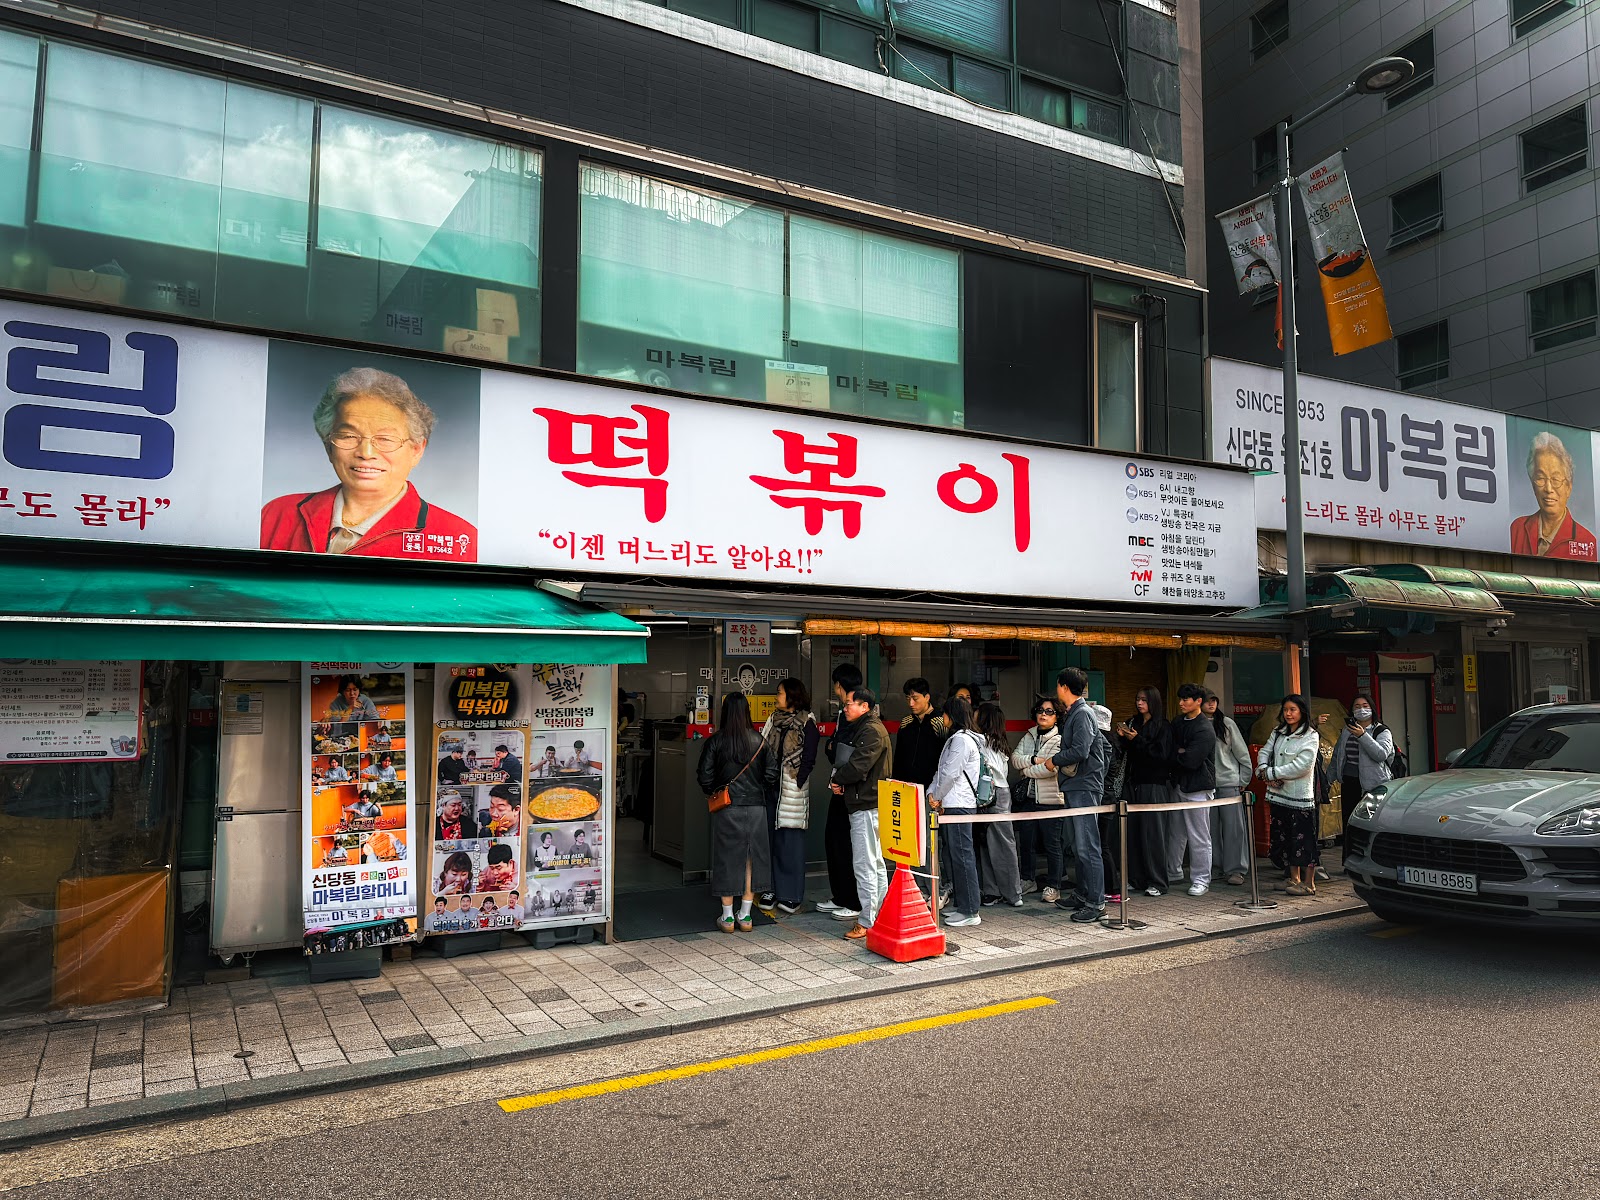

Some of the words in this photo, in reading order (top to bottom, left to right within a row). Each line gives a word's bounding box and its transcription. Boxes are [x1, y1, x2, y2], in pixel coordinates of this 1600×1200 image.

[387, 313, 423, 336] 마복림
[646, 348, 736, 378] 마복림
[836, 375, 918, 401] 마복림
[3, 320, 179, 480] 림
[1236, 388, 1283, 414] SINCE
[1298, 399, 1325, 421] 953
[1226, 427, 1274, 471] 신당동
[1340, 405, 1498, 504] 마복림
[532, 403, 1031, 553] 떡볶이
[1139, 467, 1154, 478] SBS
[1159, 469, 1173, 480] 리얼
[1176, 471, 1197, 483] 코리아
[1138, 489, 1153, 498] KBS
[1159, 484, 1171, 493] 6시
[1174, 485, 1195, 496] 내고향
[1160, 494, 1189, 506] 무엇이든
[1190, 497, 1225, 509] 물어보세요
[1139, 513, 1153, 521] KBS
[1161, 508, 1171, 517] VJ
[1173, 509, 1194, 520] 특공대
[1355, 505, 1383, 529] 몰라
[1389, 509, 1430, 531] 아무도
[1161, 518, 1182, 530] 생방송
[1184, 520, 1205, 531] 전국은
[1207, 523, 1222, 534] 지금
[428, 534, 454, 547] 마복림
[1161, 533, 1182, 544] 아침을
[1185, 535, 1206, 547] 달린다
[619, 536, 717, 568] 며느리도
[1161, 558, 1181, 569] 맛있는
[1183, 560, 1203, 571] 녀석들
[1130, 570, 1153, 582] tvN
[1161, 572, 1168, 582] 유
[1170, 573, 1184, 583] 퀴즈
[1185, 573, 1193, 583] 온
[1194, 574, 1201, 584] 더
[1134, 584, 1150, 597] CF
[1161, 586, 1182, 598] 해찬들
[1184, 588, 1204, 599] 태양초
[1206, 590, 1225, 601] 고추장
[730, 624, 758, 636] 포장은
[739, 636, 767, 648] 안으로
[457, 680, 510, 698] 마복림
[457, 698, 509, 715] 떡볶이
[534, 707, 594, 719] 신당동마복림
[544, 717, 584, 728] 떡볶이집
[892, 790, 902, 846] 출입구
[312, 871, 356, 888] 신당동
[1406, 868, 1437, 885] 101너
[1441, 873, 1473, 889] 8585
[313, 881, 407, 905] 마복림할머니
[497, 914, 514, 927] 안다
